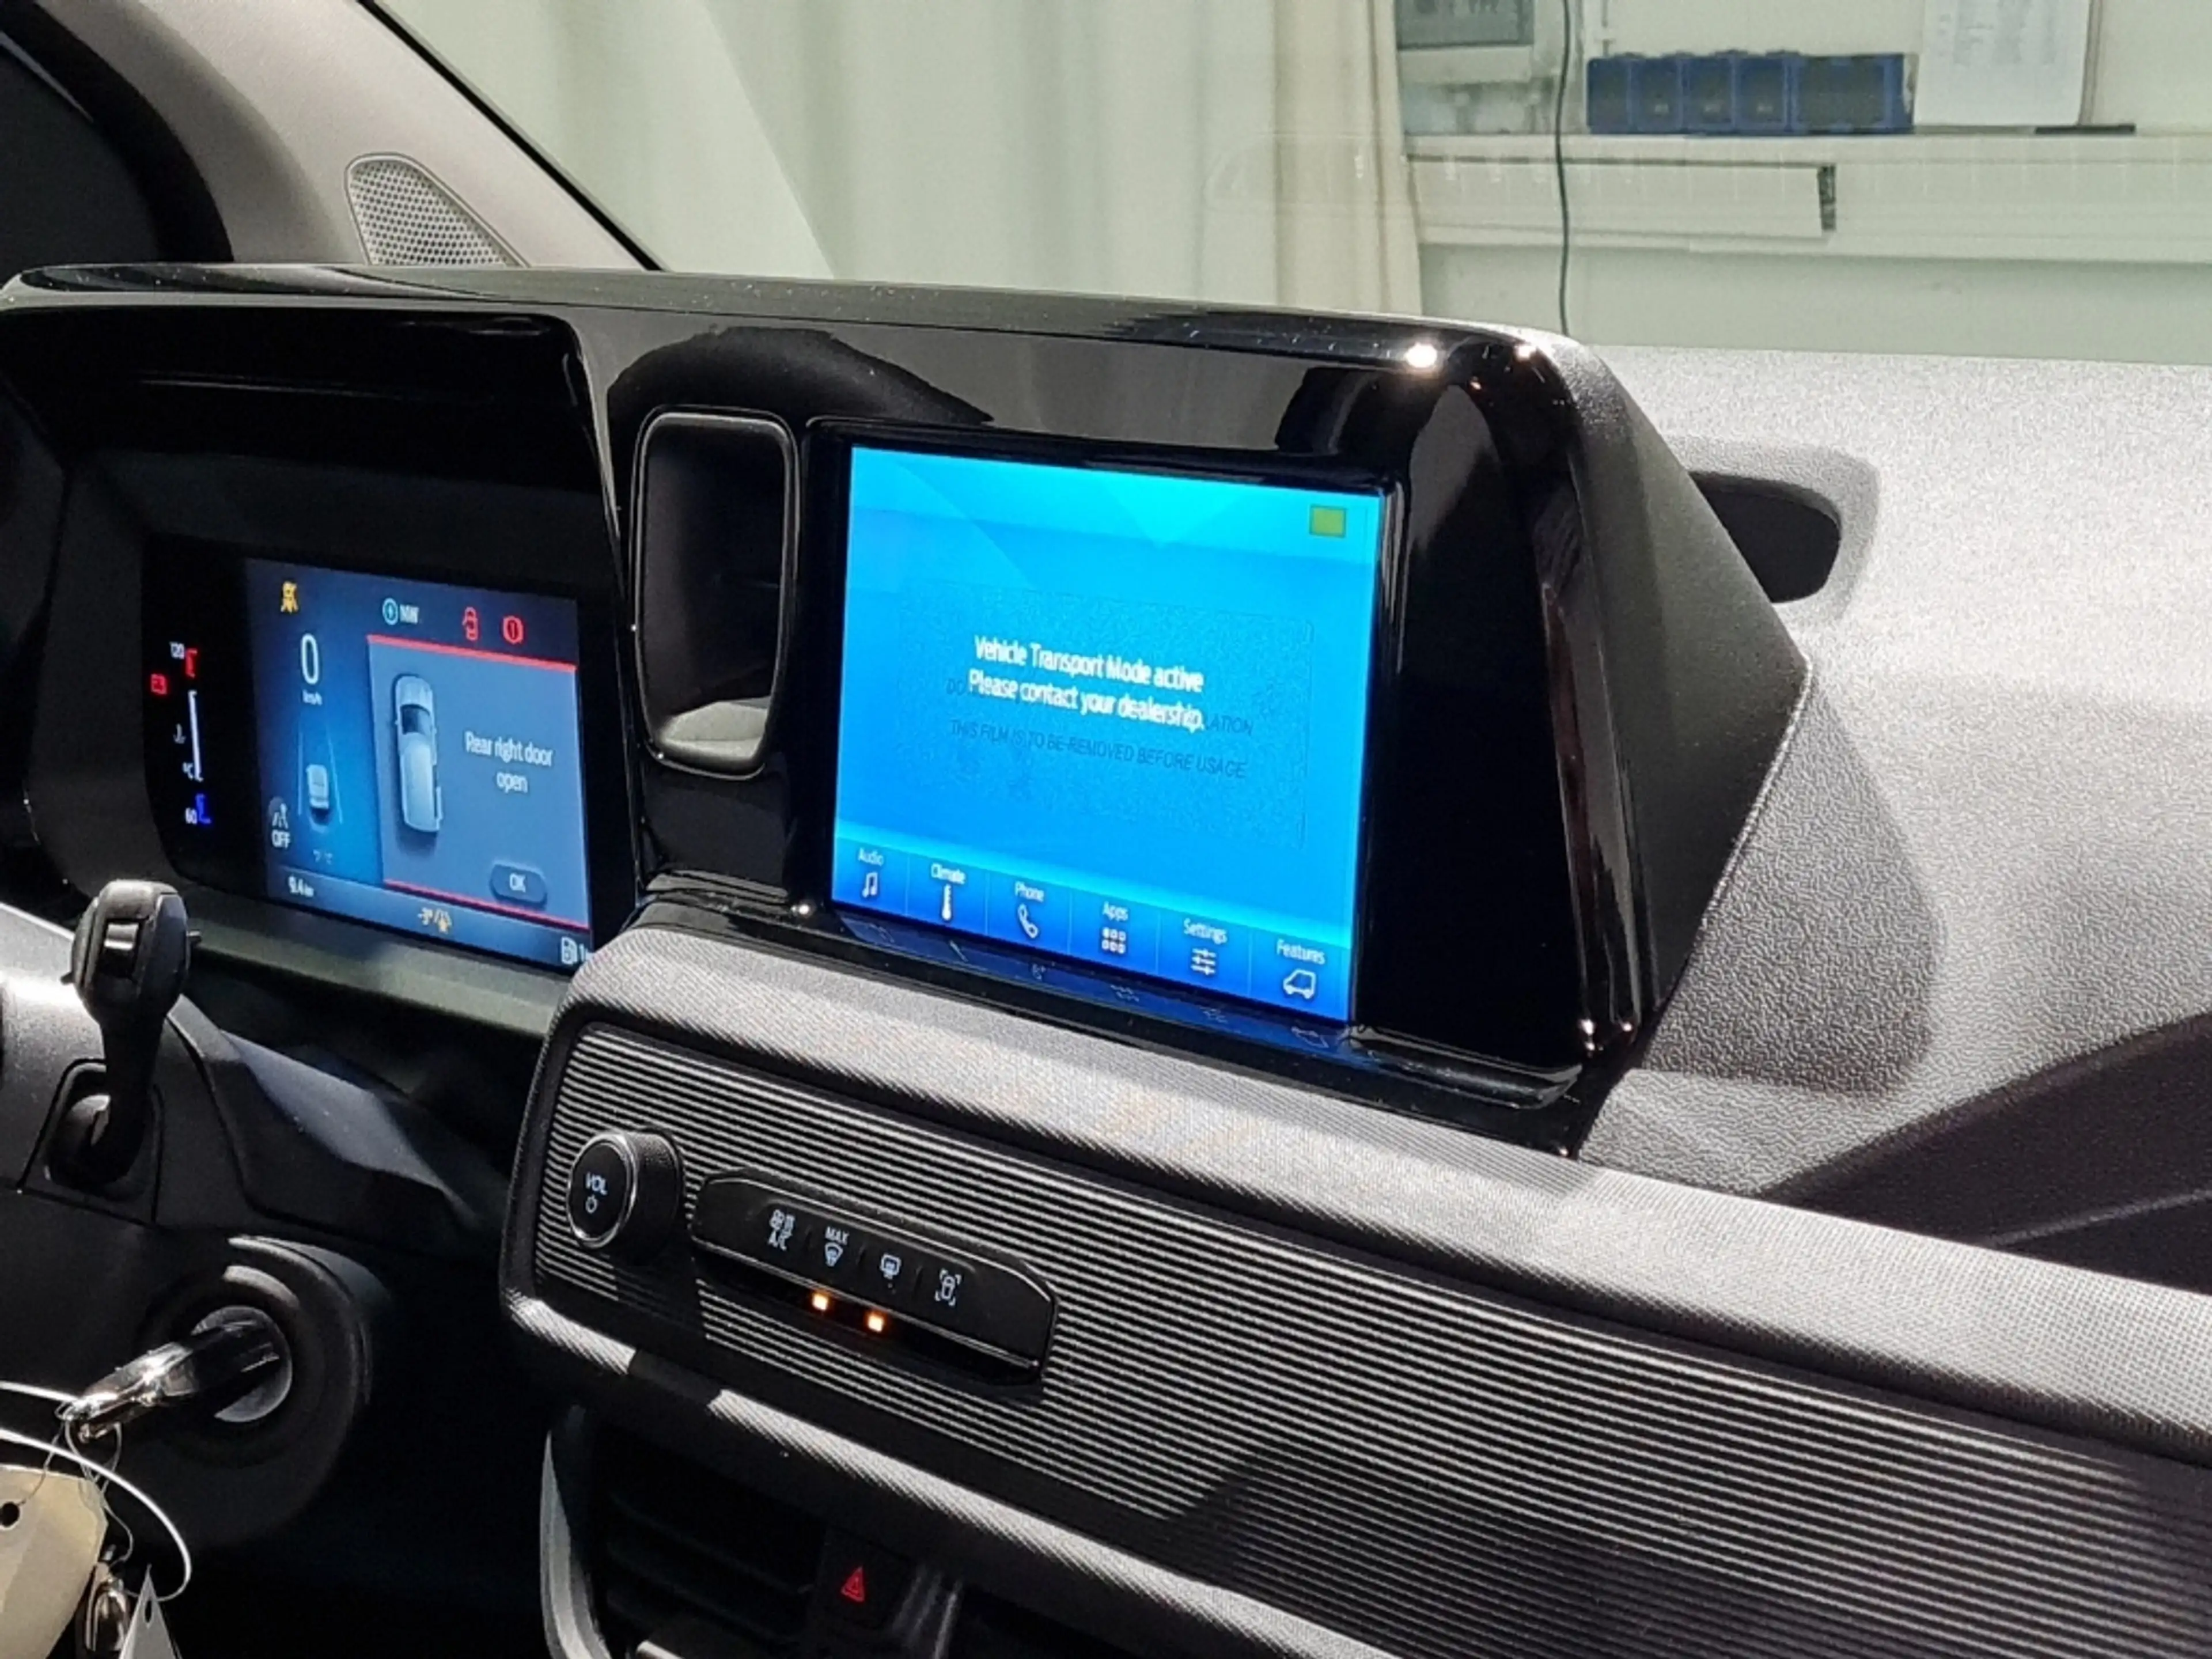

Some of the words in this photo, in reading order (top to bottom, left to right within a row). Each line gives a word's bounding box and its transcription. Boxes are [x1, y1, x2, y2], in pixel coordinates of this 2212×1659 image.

[300, 633, 319, 684] 0
[975, 635, 1028, 666] Vehicle
[1030, 642, 1104, 679] Transport
[1106, 654, 1151, 684] Mode
[1154, 665, 1203, 692] active
[969, 668, 1018, 700] Please
[1020, 683, 1078, 710] contact
[1080, 691, 1116, 715] your
[1118, 693, 1205, 733] dealership.
[465, 730, 493, 756] Rear
[495, 736, 524, 763] right
[525, 741, 553, 767] door
[950, 719, 978, 741] THIS
[980, 723, 1008, 745] FILM
[1013, 728, 1028, 747] IS
[1029, 730, 1045, 748] TO
[1047, 733, 1065, 751] BE
[1069, 737, 1134, 763] REMOVED
[1137, 748, 1195, 772] BEFORE
[1196, 755, 1247, 779] USAGE
[497, 772, 528, 794] open
[271, 830, 290, 849] OFF
[858, 847, 884, 867] Audio
[509, 873, 527, 892] OK
[931, 862, 967, 885] Climate
[1014, 881, 1045, 903] Phone
[1102, 900, 1130, 923] Apps
[1183, 918, 1228, 945] Settings
[1277, 938, 1326, 965] Features
[585, 1171, 608, 1196] VOL
[767, 1230, 788, 1252] A/C
[825, 1226, 850, 1246] MAX
